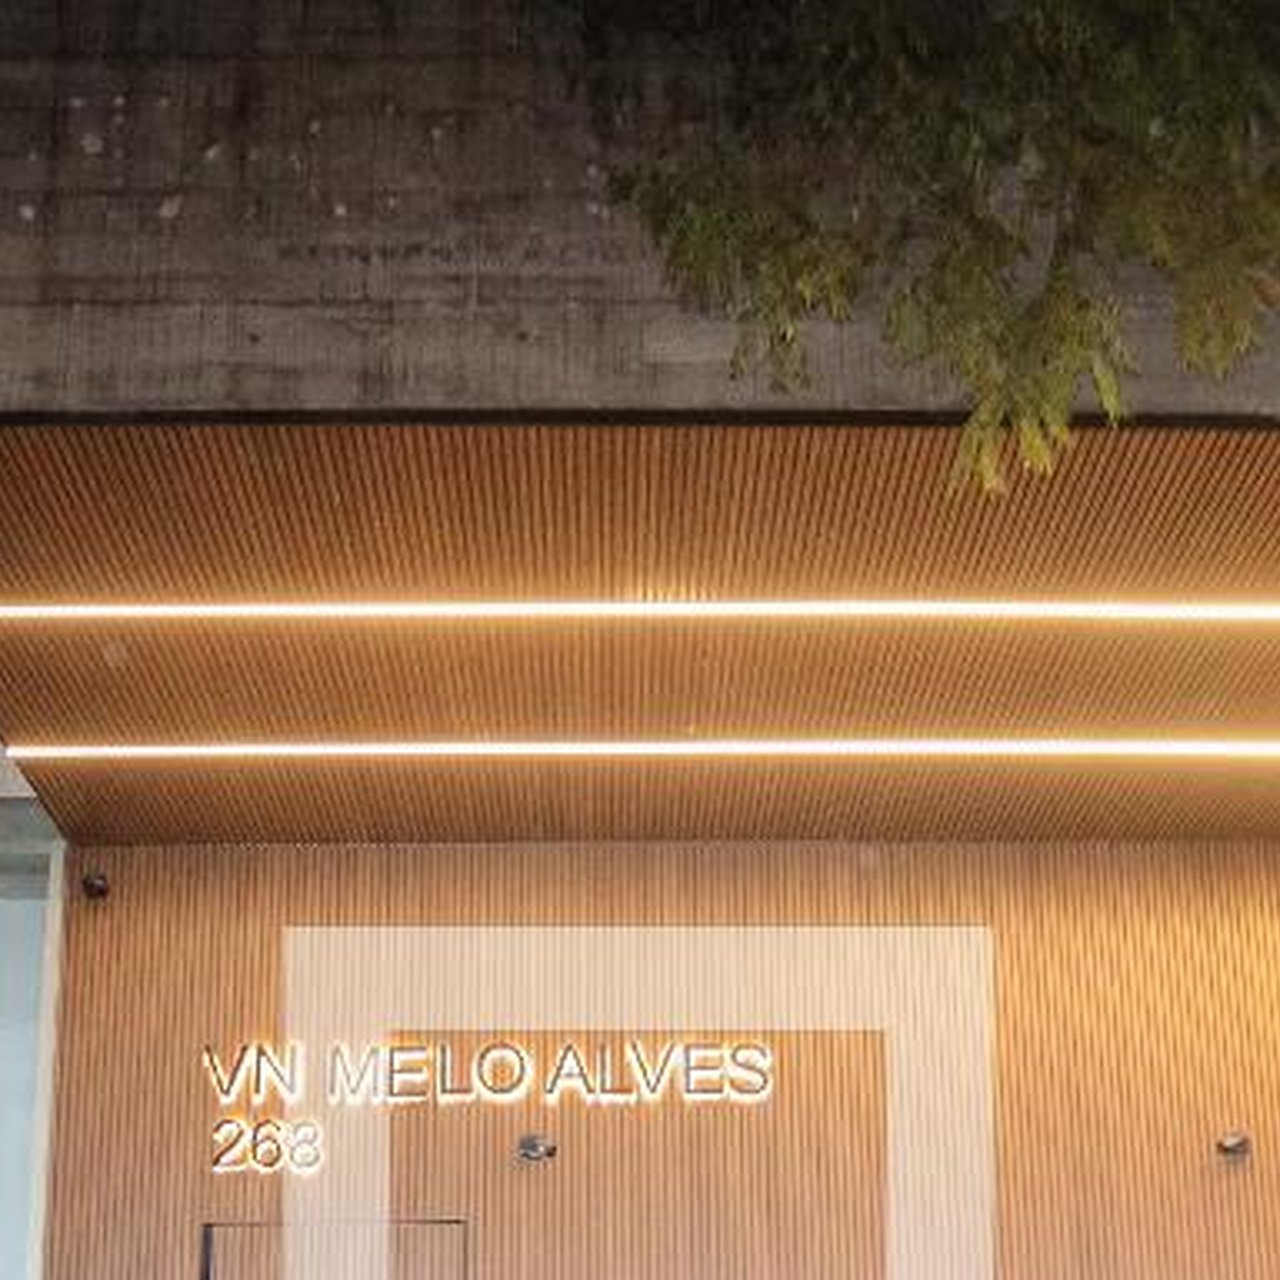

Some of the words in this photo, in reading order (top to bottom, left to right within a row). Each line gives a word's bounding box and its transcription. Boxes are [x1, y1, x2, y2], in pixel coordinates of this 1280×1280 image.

[204, 1041, 299, 1101] VN
[327, 1041, 531, 1103] MELO
[544, 1041, 775, 1103] ALVES
[211, 1117, 322, 1173] 268
